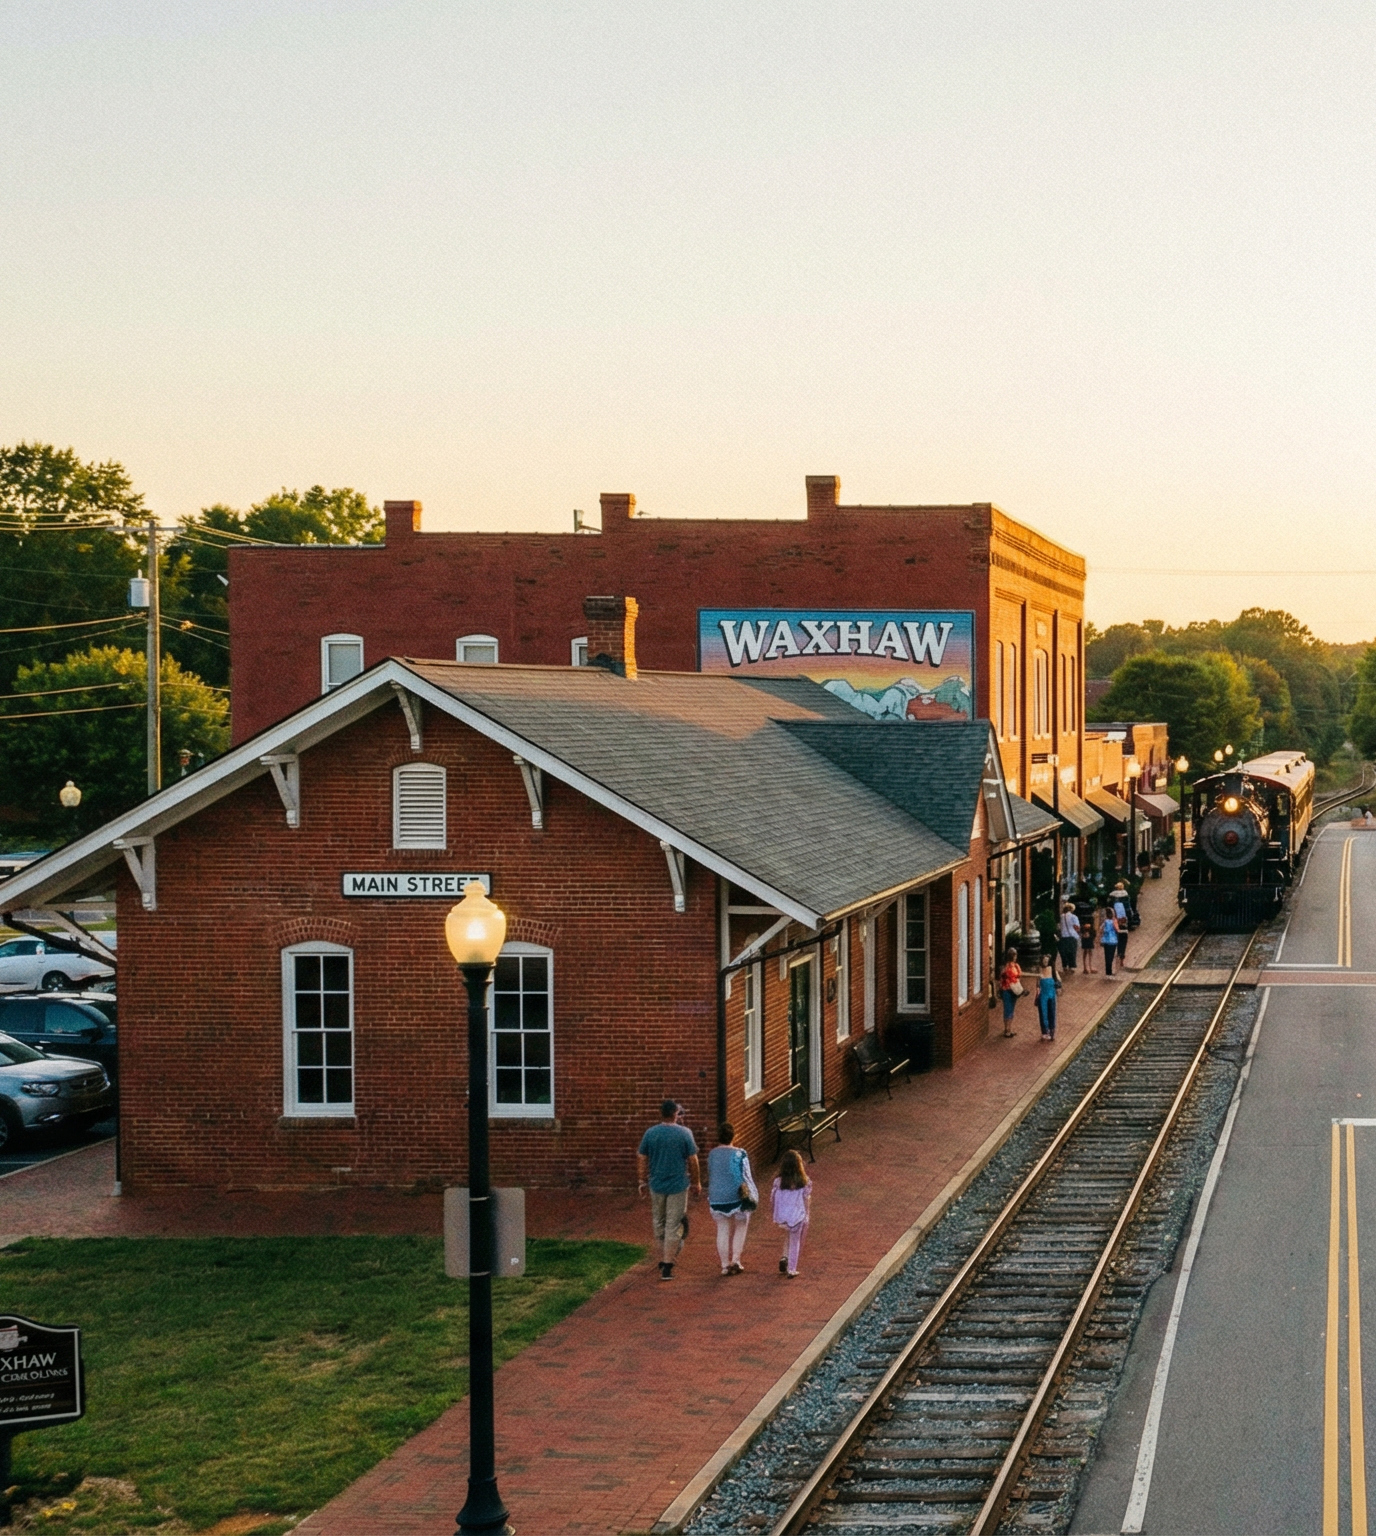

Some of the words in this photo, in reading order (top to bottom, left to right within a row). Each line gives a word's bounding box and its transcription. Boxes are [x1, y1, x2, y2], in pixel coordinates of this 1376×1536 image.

[718, 619, 954, 668] WAXHAW
[352, 876, 399, 893] MAIN
[407, 876, 480, 893] STREE
